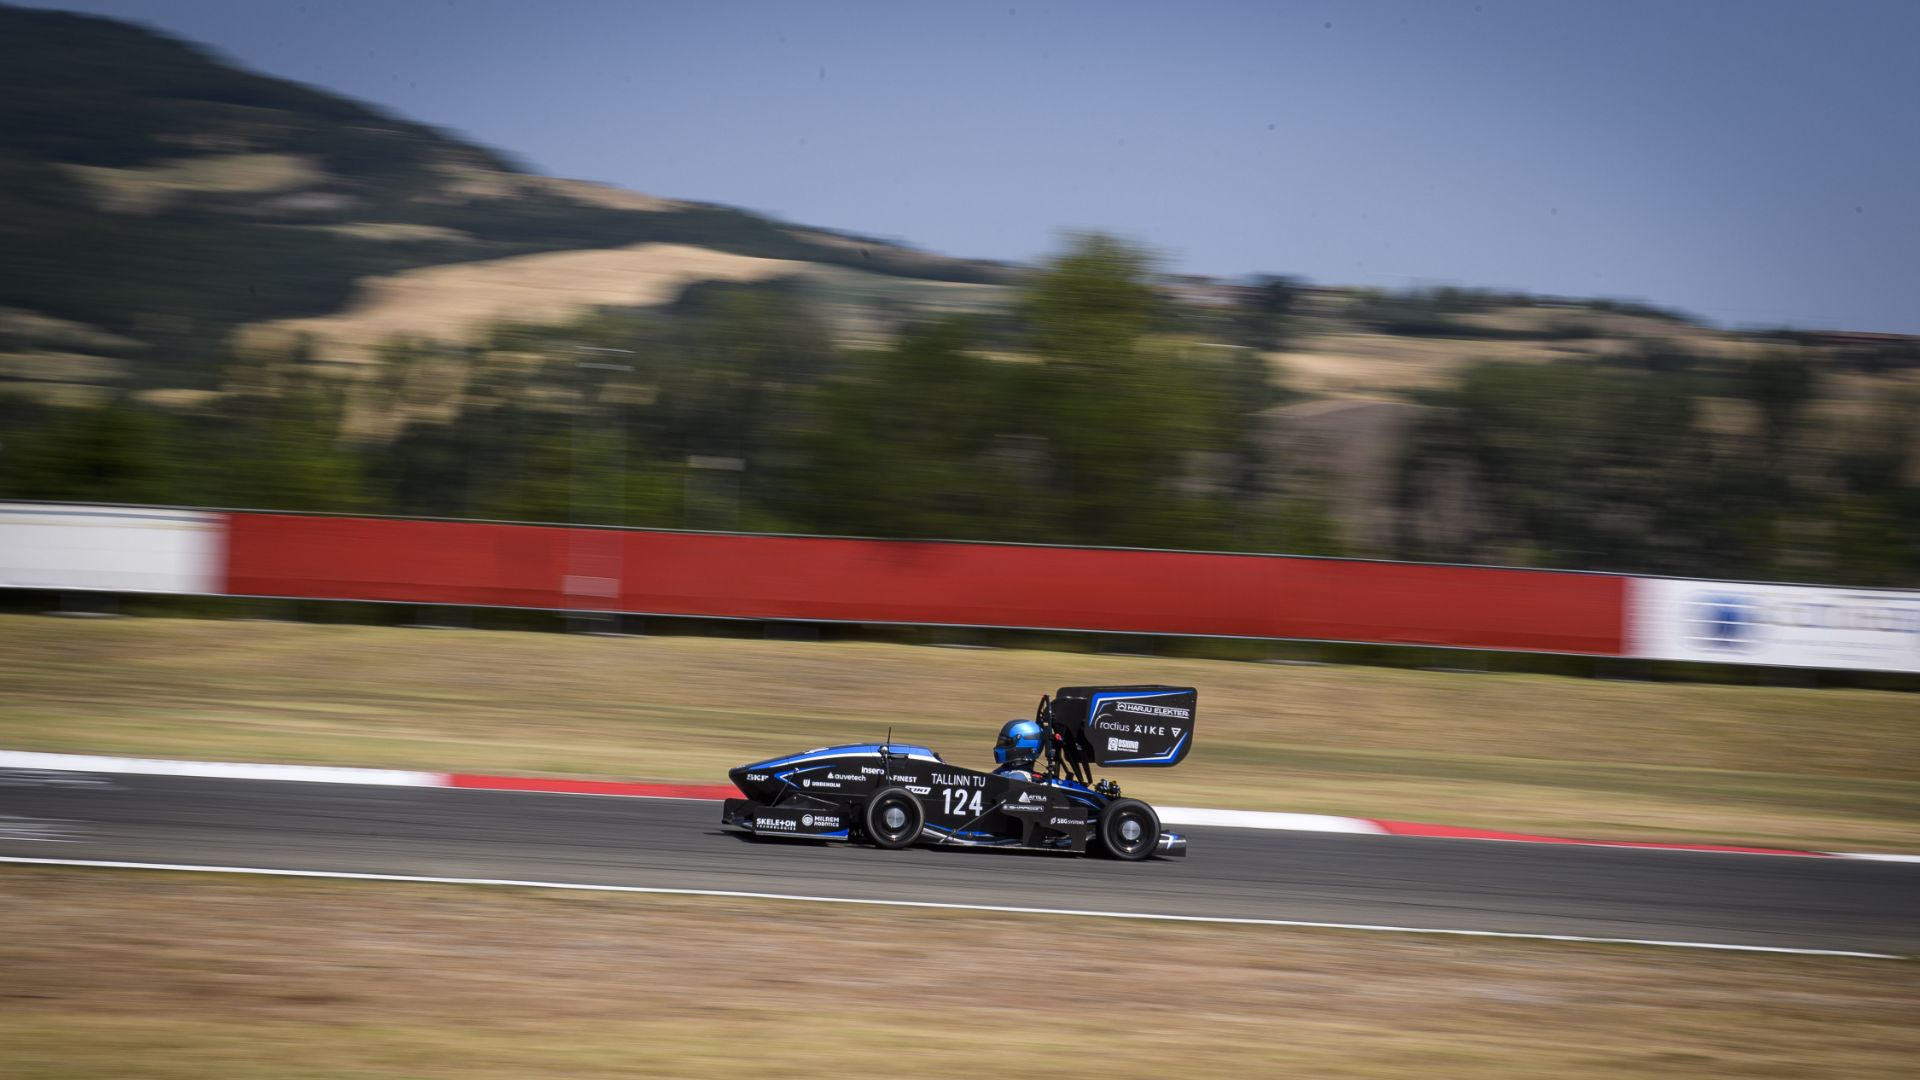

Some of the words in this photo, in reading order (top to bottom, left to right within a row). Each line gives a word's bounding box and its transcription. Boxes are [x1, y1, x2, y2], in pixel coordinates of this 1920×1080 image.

[1100, 721, 1130, 732] radius
[746, 773, 769, 781] SKF
[834, 773, 867, 782] auvetech
[893, 775, 917, 783] FINEST
[931, 773, 970, 786] TALLINN
[973, 776, 986, 788] TU
[942, 788, 983, 817] 124
